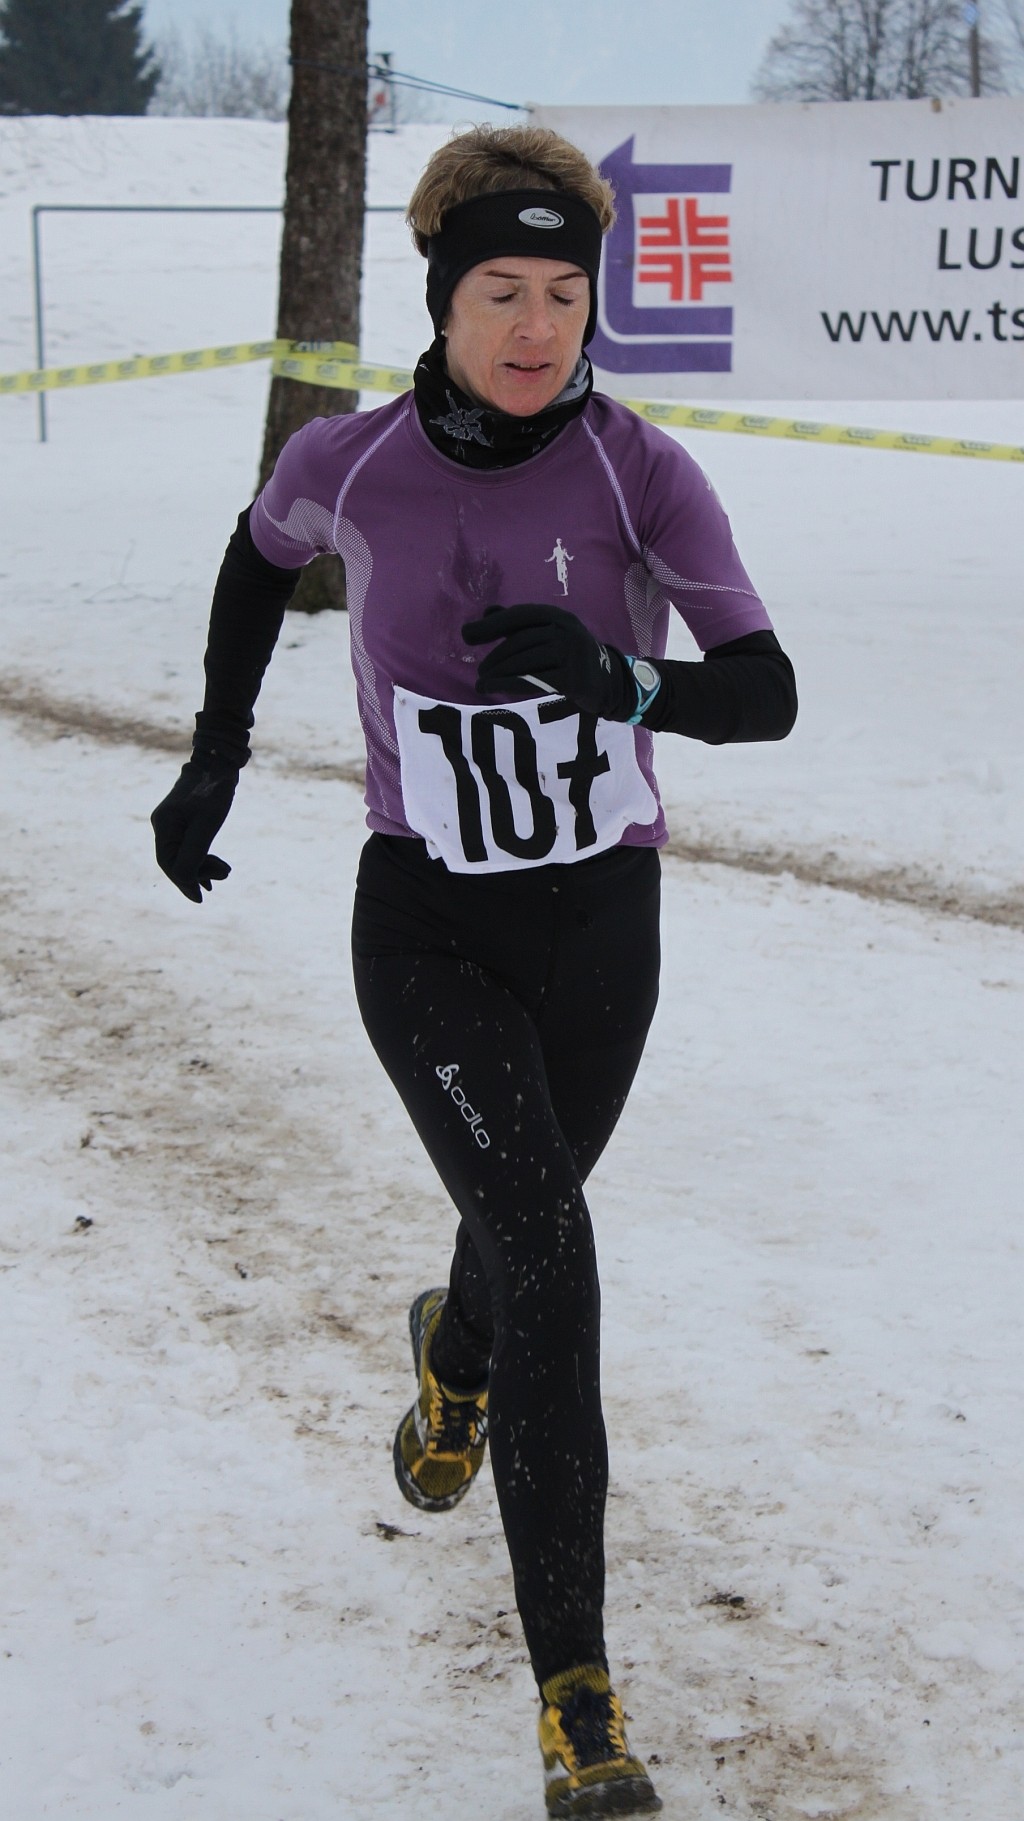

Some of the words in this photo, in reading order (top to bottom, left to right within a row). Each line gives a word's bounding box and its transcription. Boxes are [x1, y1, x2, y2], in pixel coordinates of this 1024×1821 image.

[870, 156, 1020, 202] TURN
[820, 300, 1024, 342] www.ts
[418, 698, 611, 862] 107
[450, 1086, 491, 1149] odlo
